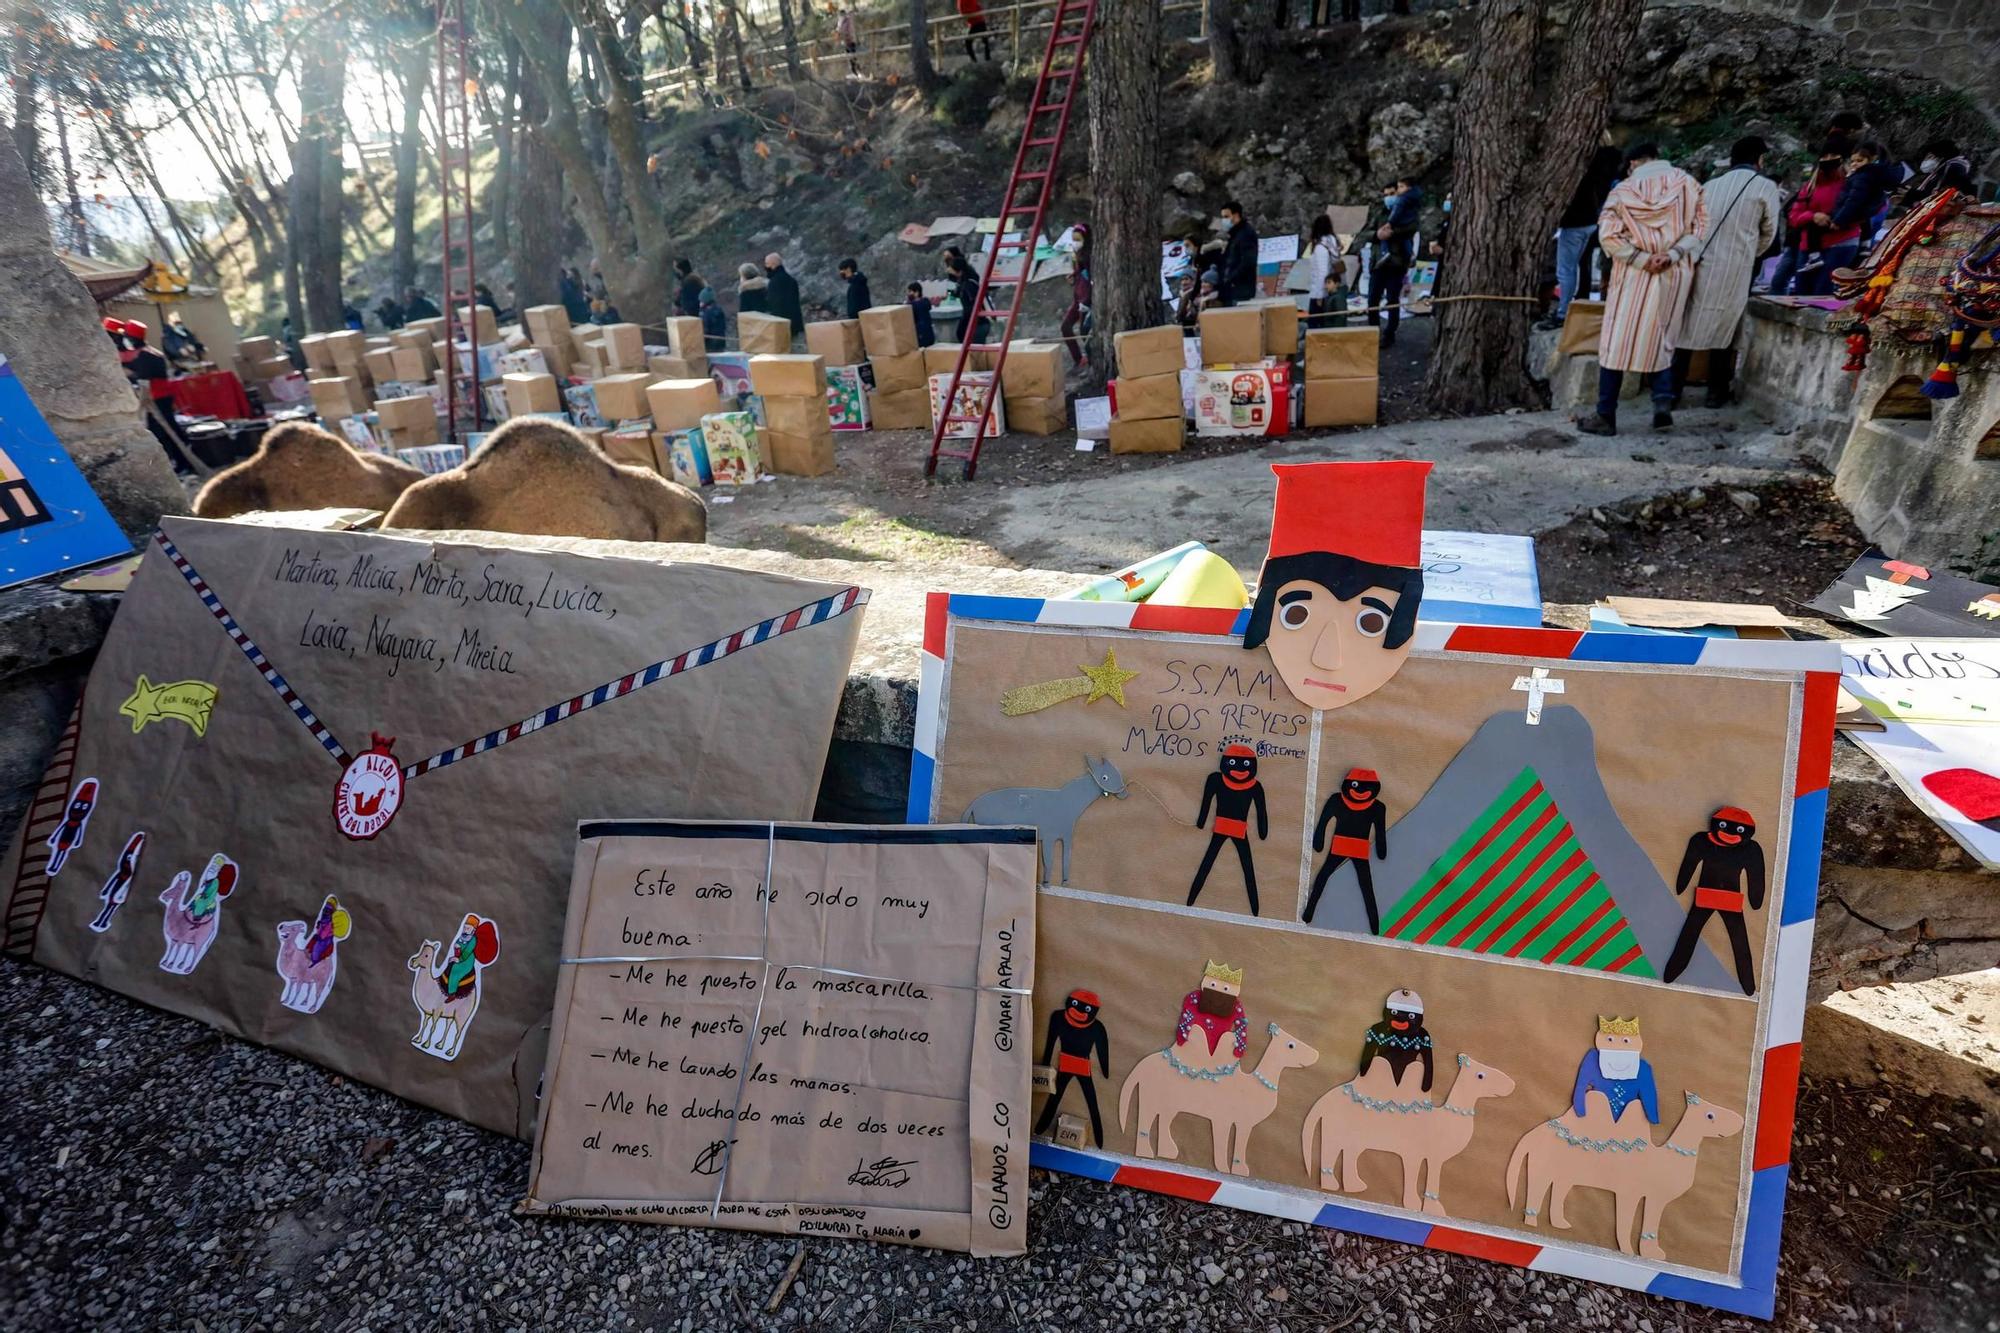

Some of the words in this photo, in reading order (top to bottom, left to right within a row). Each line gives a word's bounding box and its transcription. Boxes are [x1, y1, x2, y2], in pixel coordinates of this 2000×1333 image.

[275, 548, 339, 591] Martina,
[346, 554, 403, 596] Alicia,
[410, 562, 469, 607] Marta,
[474, 563, 534, 618] Sara,
[300, 608, 355, 659] Laia,
[366, 614, 445, 677] Nayara,
[454, 628, 516, 674] Mireia
[1221, 703, 1306, 737] REYES
[1122, 726, 1209, 757] MAGOS
[366, 756, 396, 781] ALCOI
[634, 869, 676, 898] Este
[696, 883, 733, 899] año
[756, 884, 778, 904] he
[804, 887, 858, 908] sido
[882, 898, 930, 919] muy
[622, 916, 703, 947] buena:
[665, 968, 688, 988] he
[700, 974, 757, 996] puesto
[775, 967, 797, 991] la
[813, 980, 934, 1002] mascarilla.
[660, 1008, 681, 1029] he
[691, 1017, 744, 1038] puesto
[760, 1020, 787, 1045] gel
[648, 1051, 669, 1073] he
[680, 1056, 737, 1080] lavado
[749, 1063, 778, 1084] las
[646, 1094, 668, 1118] he
[820, 1110, 843, 1129] de
[857, 1114, 888, 1134] dos
[897, 1121, 945, 1138] veces
[583, 1131, 601, 1150] al
[612, 1142, 653, 1159] mes.
[717, 1205, 745, 1214] AURA
